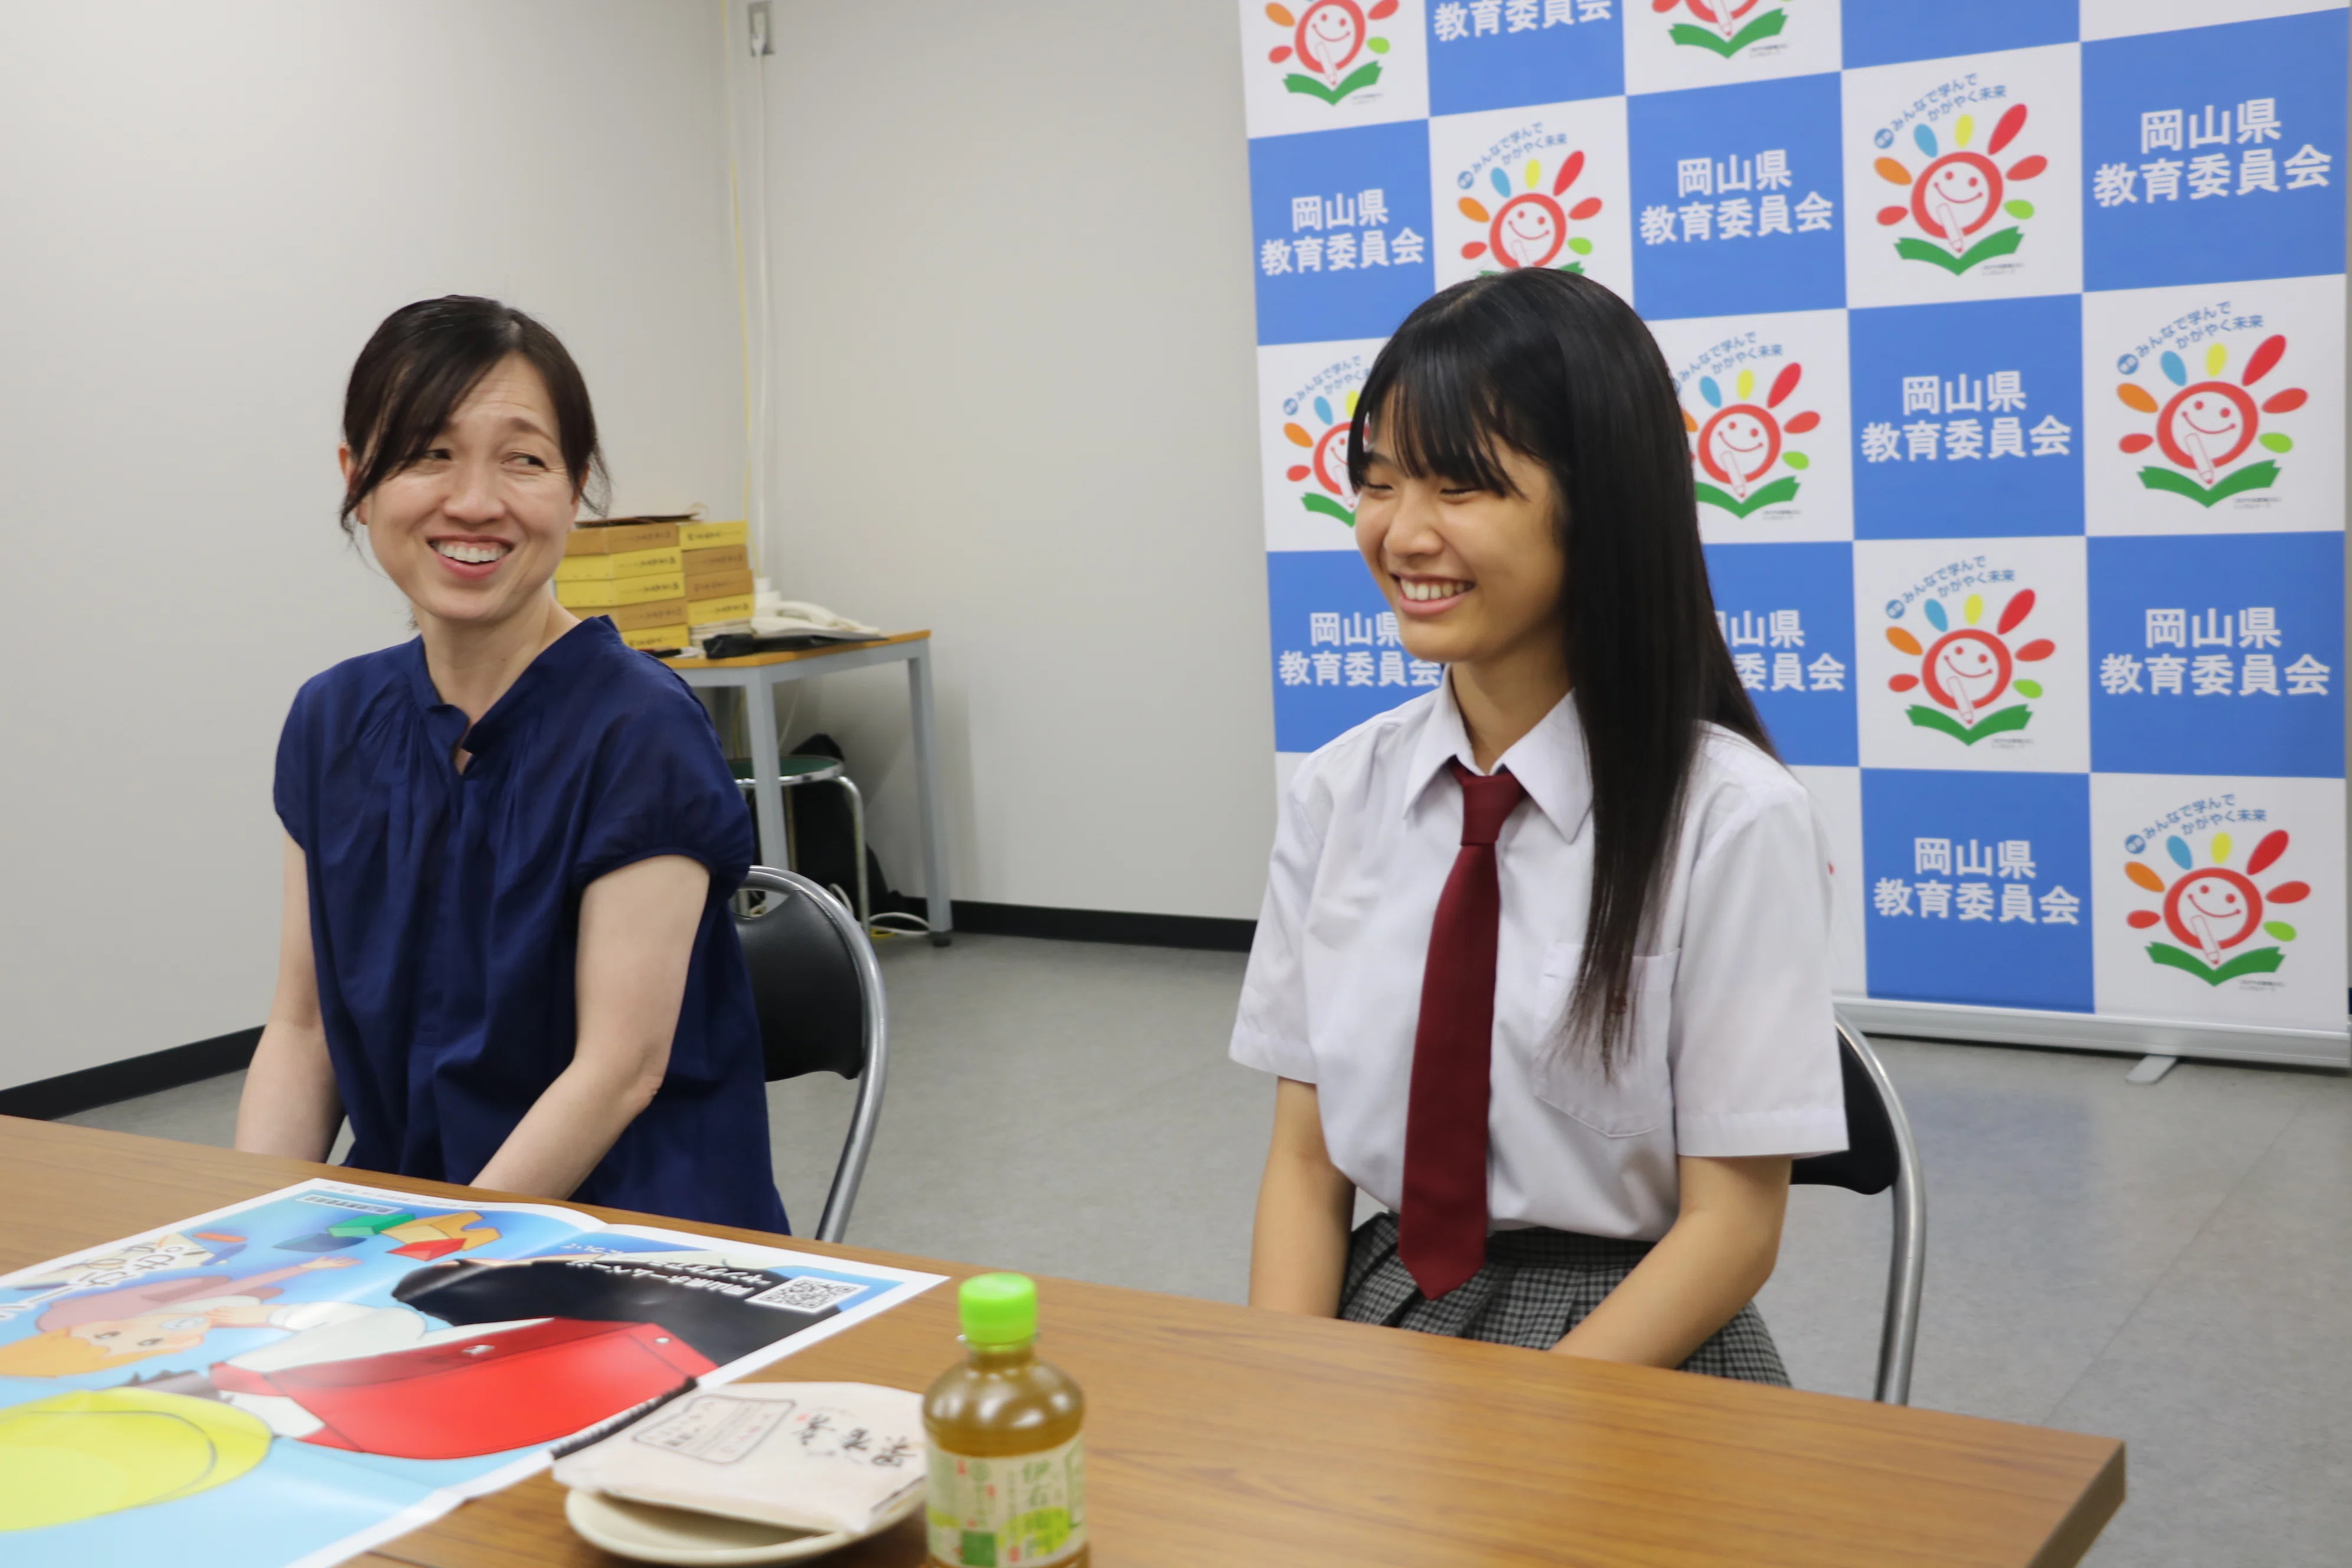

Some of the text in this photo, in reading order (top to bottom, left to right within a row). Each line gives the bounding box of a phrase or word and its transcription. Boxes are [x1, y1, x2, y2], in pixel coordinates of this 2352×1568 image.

[1890, 72, 1977, 131] みんなで学んで
[1928, 84, 2007, 122] かがやく未来
[1471, 121, 1543, 172] みんなで学んで
[2141, 97, 2281, 154] 岡山県
[1502, 132, 1567, 166] かがやく未来
[1677, 149, 1792, 198] 岡山県
[2093, 144, 2332, 207] 教育委員会
[1291, 188, 1389, 233] 岡山県
[1639, 191, 1833, 246] 教育委員会
[1260, 227, 1425, 276] 教育委員会
[2135, 300, 2232, 357] みんなで学んで
[2175, 315, 2263, 349] かがやく未来
[1295, 355, 1361, 401] みんなで学んで
[1678, 331, 1757, 382] みんなで学んで
[1712, 344, 1782, 374] かがやく未来
[1903, 371, 2027, 416] 岡山県
[1861, 415, 2071, 462] 教育委員会
[1902, 555, 1986, 603] みんなで学んで
[1937, 569, 2015, 598] かがやく未来
[1310, 611, 1401, 647] 岡山県
[1715, 610, 1805, 648] 山県
[2146, 607, 2281, 649] 岡山県
[1278, 650, 1441, 687] 教育委員会
[1733, 652, 1845, 692] 委員会
[2100, 653, 2330, 696] 教育委員会
[2142, 793, 2236, 839] みんなで学んで
[2182, 809, 2267, 835] かがやく未来
[1915, 838, 2036, 879] 岡山県
[1874, 878, 2079, 925] 教育委員会
